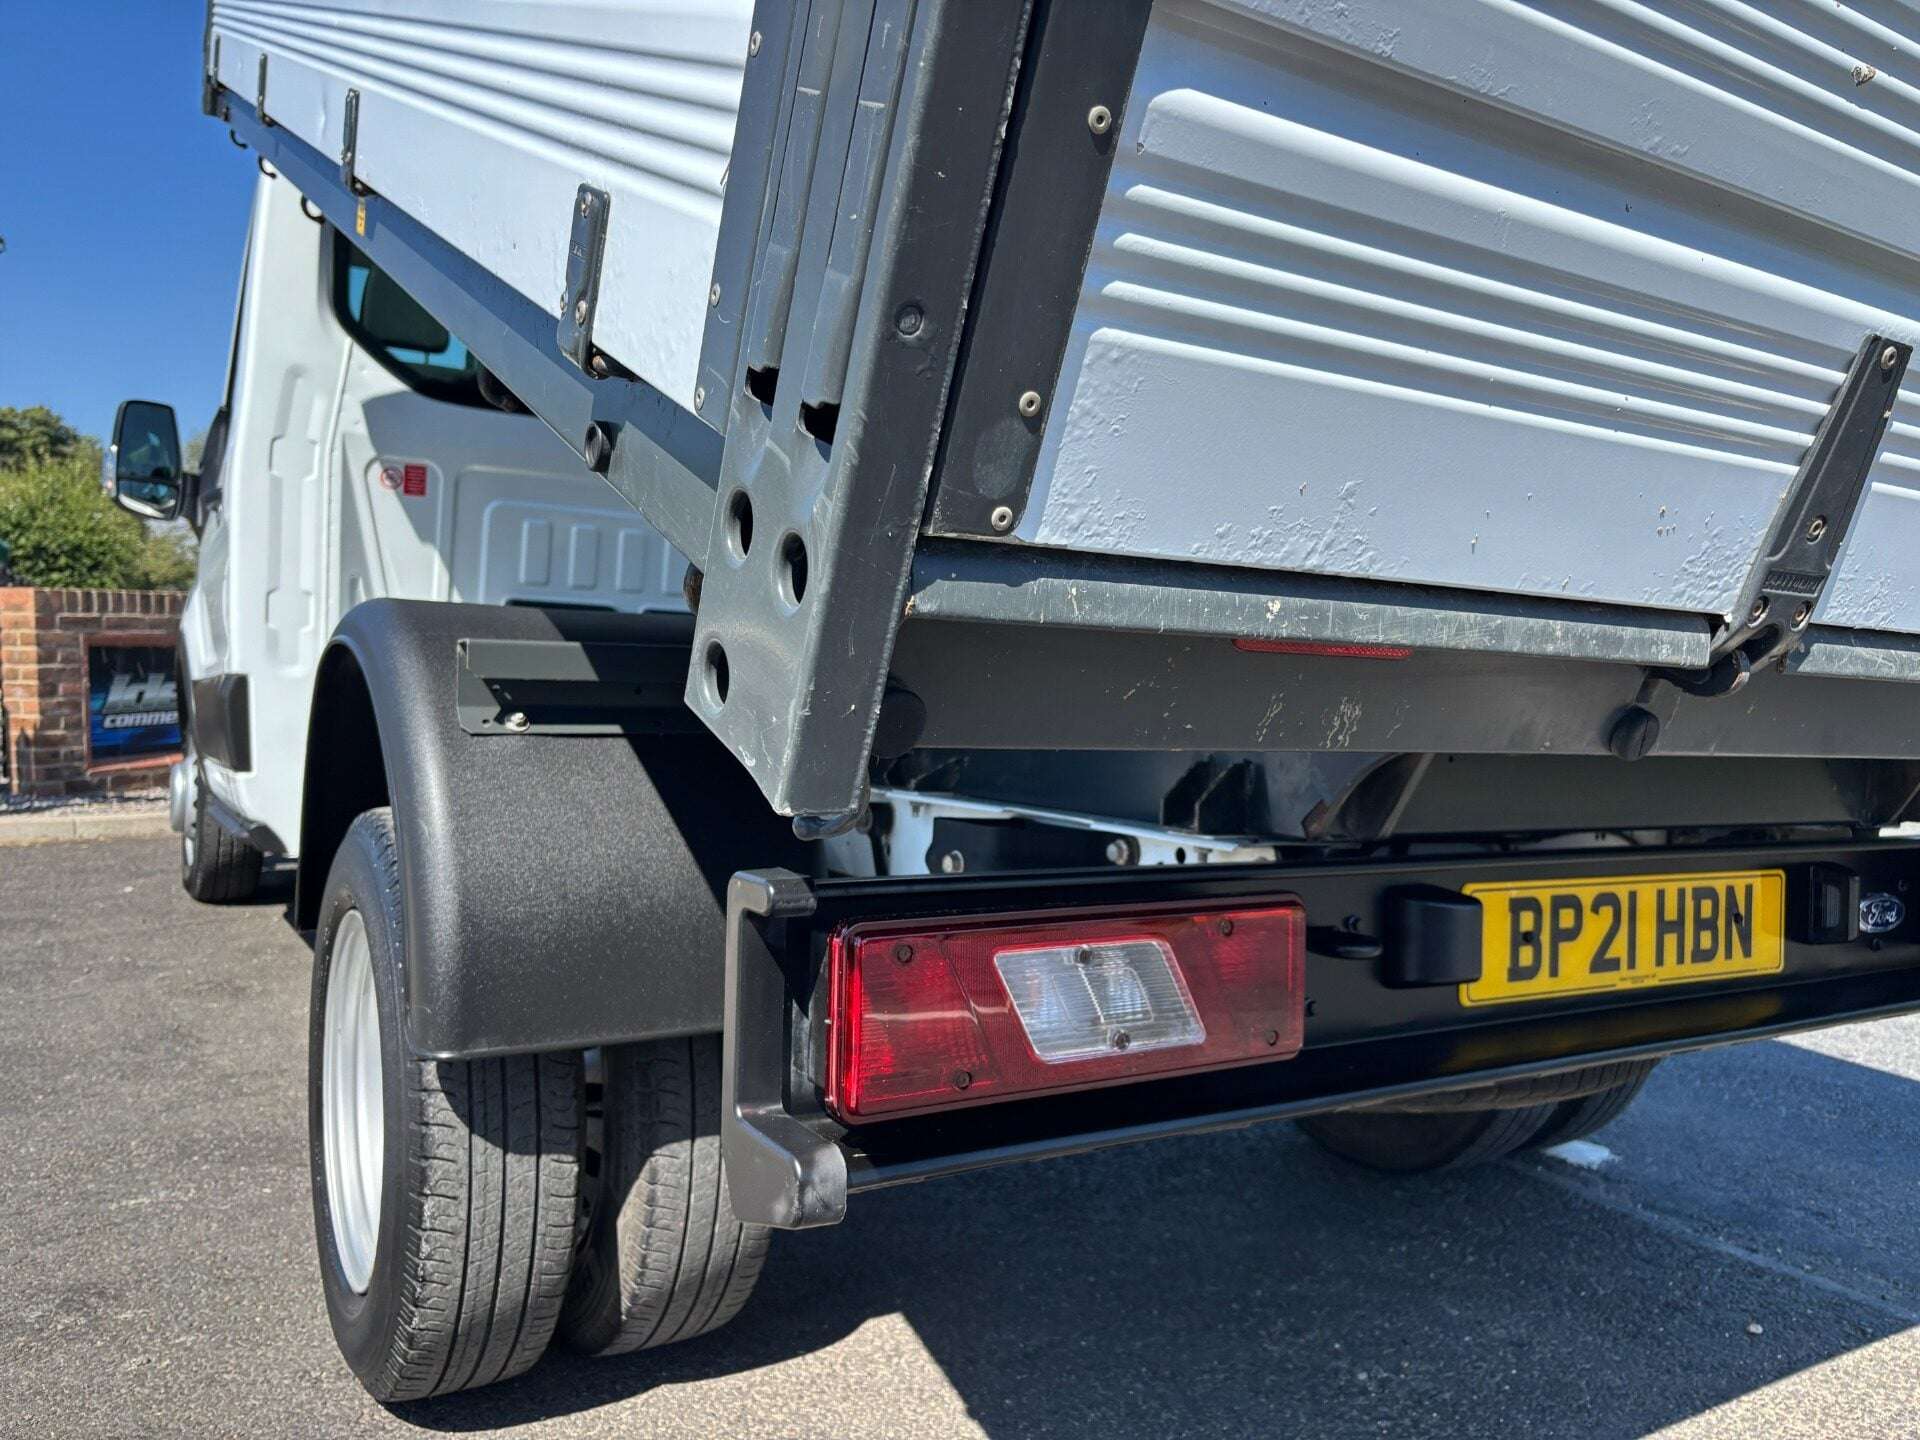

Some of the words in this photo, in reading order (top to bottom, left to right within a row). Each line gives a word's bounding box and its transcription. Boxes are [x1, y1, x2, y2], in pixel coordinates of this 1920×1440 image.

[103, 708, 178, 728] comme
[1508, 890, 1637, 982] BP21
[1655, 885, 1753, 967] HBN
